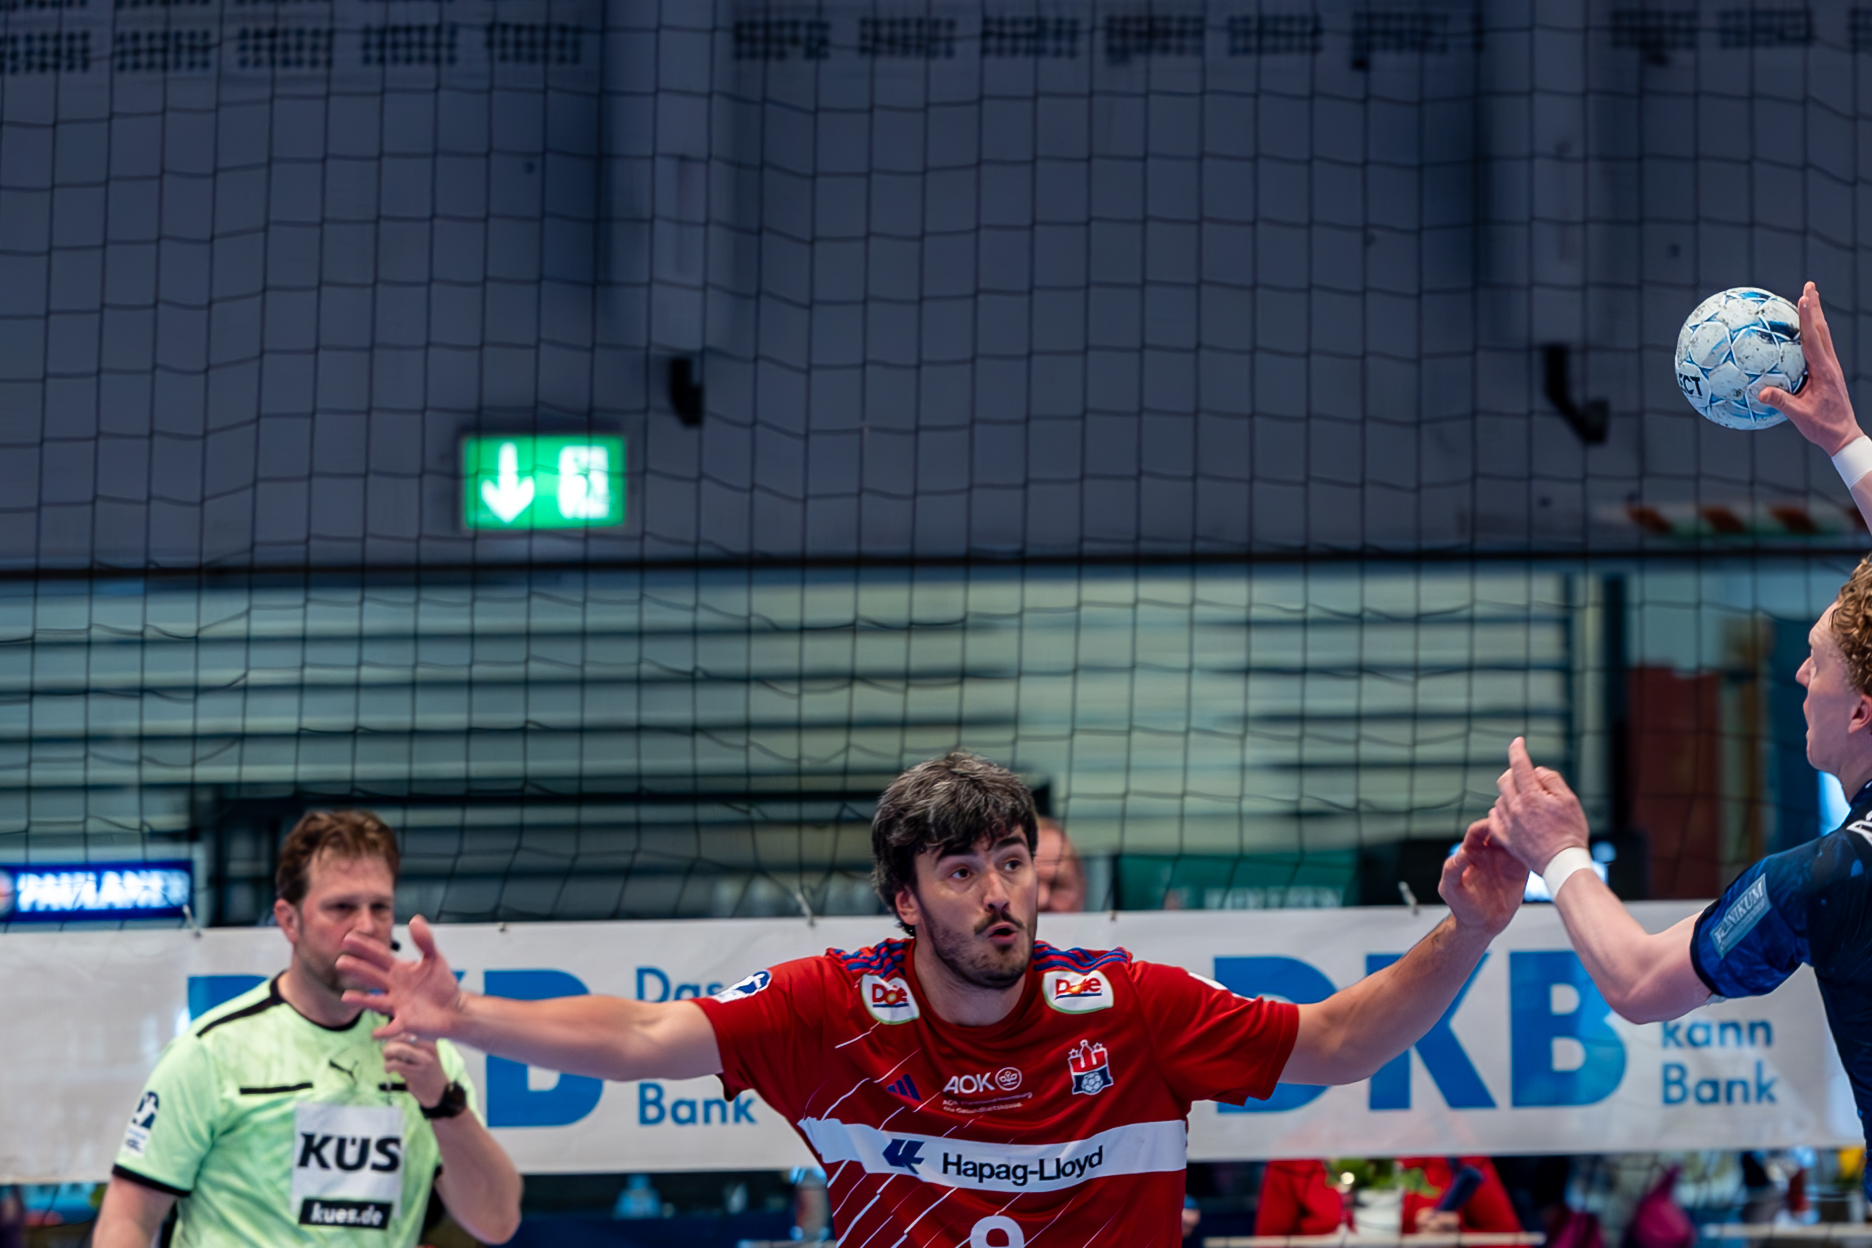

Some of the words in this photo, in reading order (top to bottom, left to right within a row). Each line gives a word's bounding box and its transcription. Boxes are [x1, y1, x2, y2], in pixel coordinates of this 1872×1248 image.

[1660, 1016, 1774, 1049] kann
[943, 1072, 996, 1094] AOK
[1661, 1062, 1777, 1106] Bank
[637, 1082, 757, 1127] Bank
[298, 1132, 402, 1173] KÜS
[942, 1145, 1103, 1186] Hapag-Lloyd
[310, 1202, 383, 1226] kues.de
